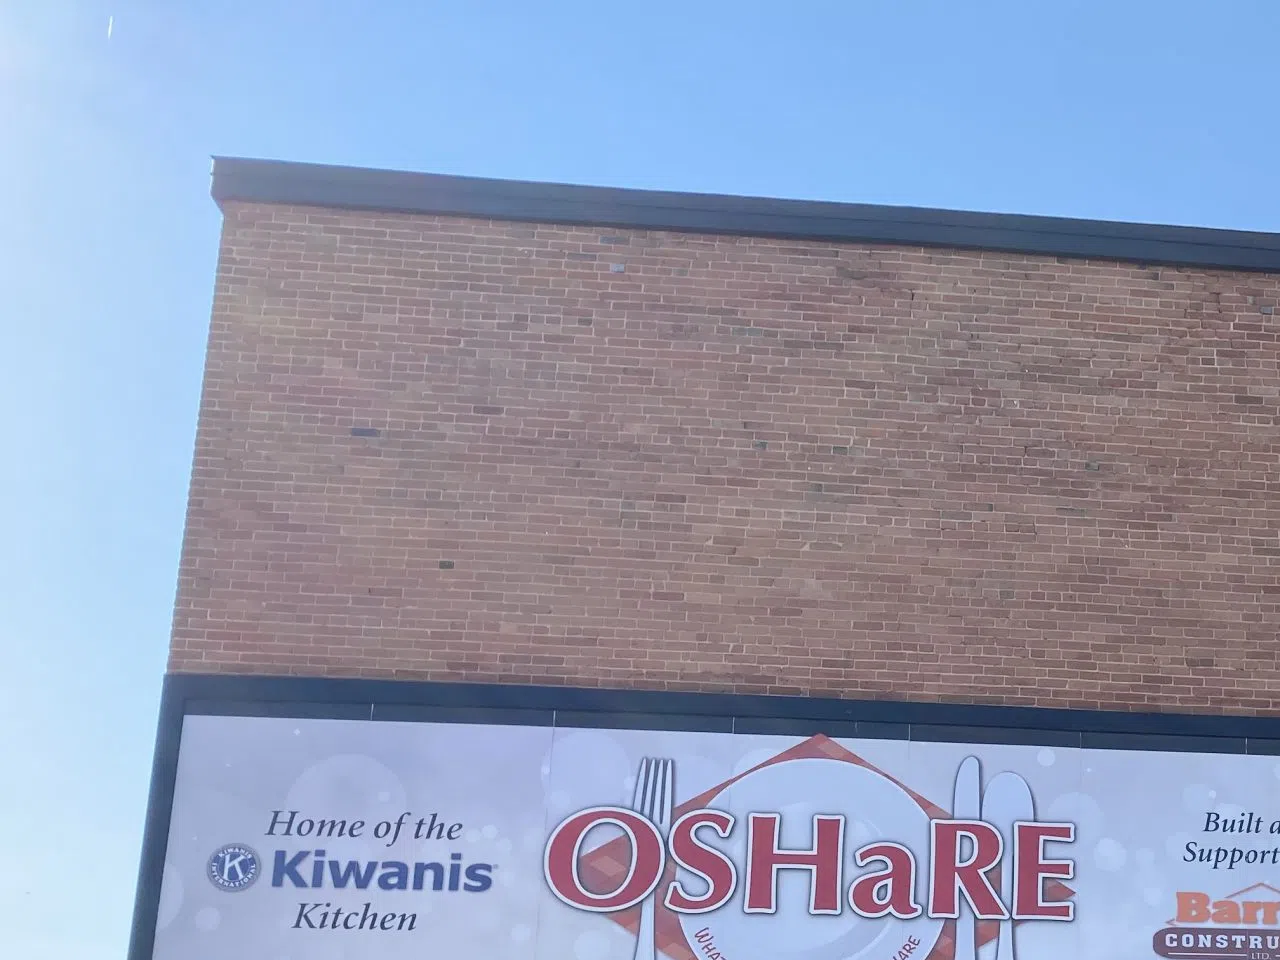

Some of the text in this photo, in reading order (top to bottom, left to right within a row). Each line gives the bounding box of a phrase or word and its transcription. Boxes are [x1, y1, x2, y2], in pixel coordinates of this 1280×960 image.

[264, 810, 463, 847] Home of the
[1203, 812, 1264, 834] Built
[271, 850, 493, 892] Kiwanis
[544, 805, 1076, 922] OSHaRE
[291, 902, 417, 931] Kitchen
